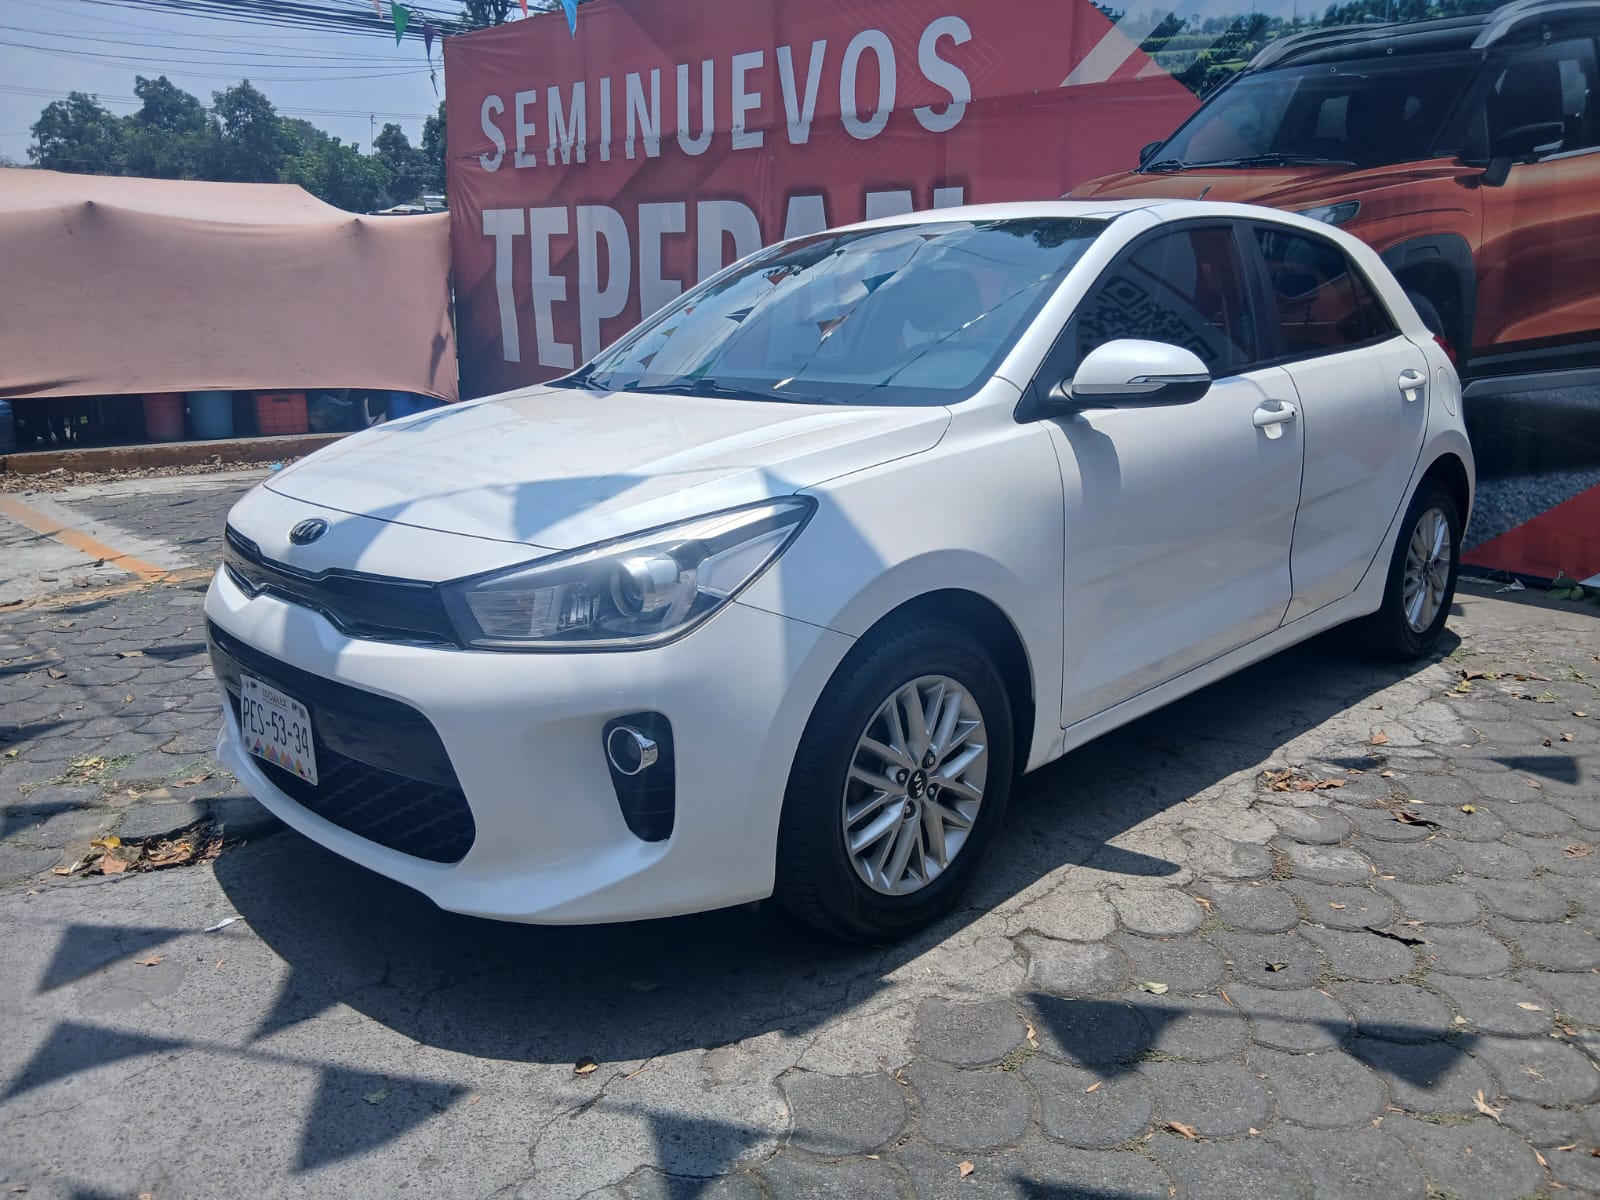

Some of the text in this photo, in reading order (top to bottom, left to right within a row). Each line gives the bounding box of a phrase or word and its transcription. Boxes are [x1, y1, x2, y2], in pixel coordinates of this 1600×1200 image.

[479, 16, 973, 173] SEMINUEVOS
[482, 186, 965, 370] TEPE
[243, 696, 310, 759] PES-53-34
[913, 772, 924, 797] KIA
